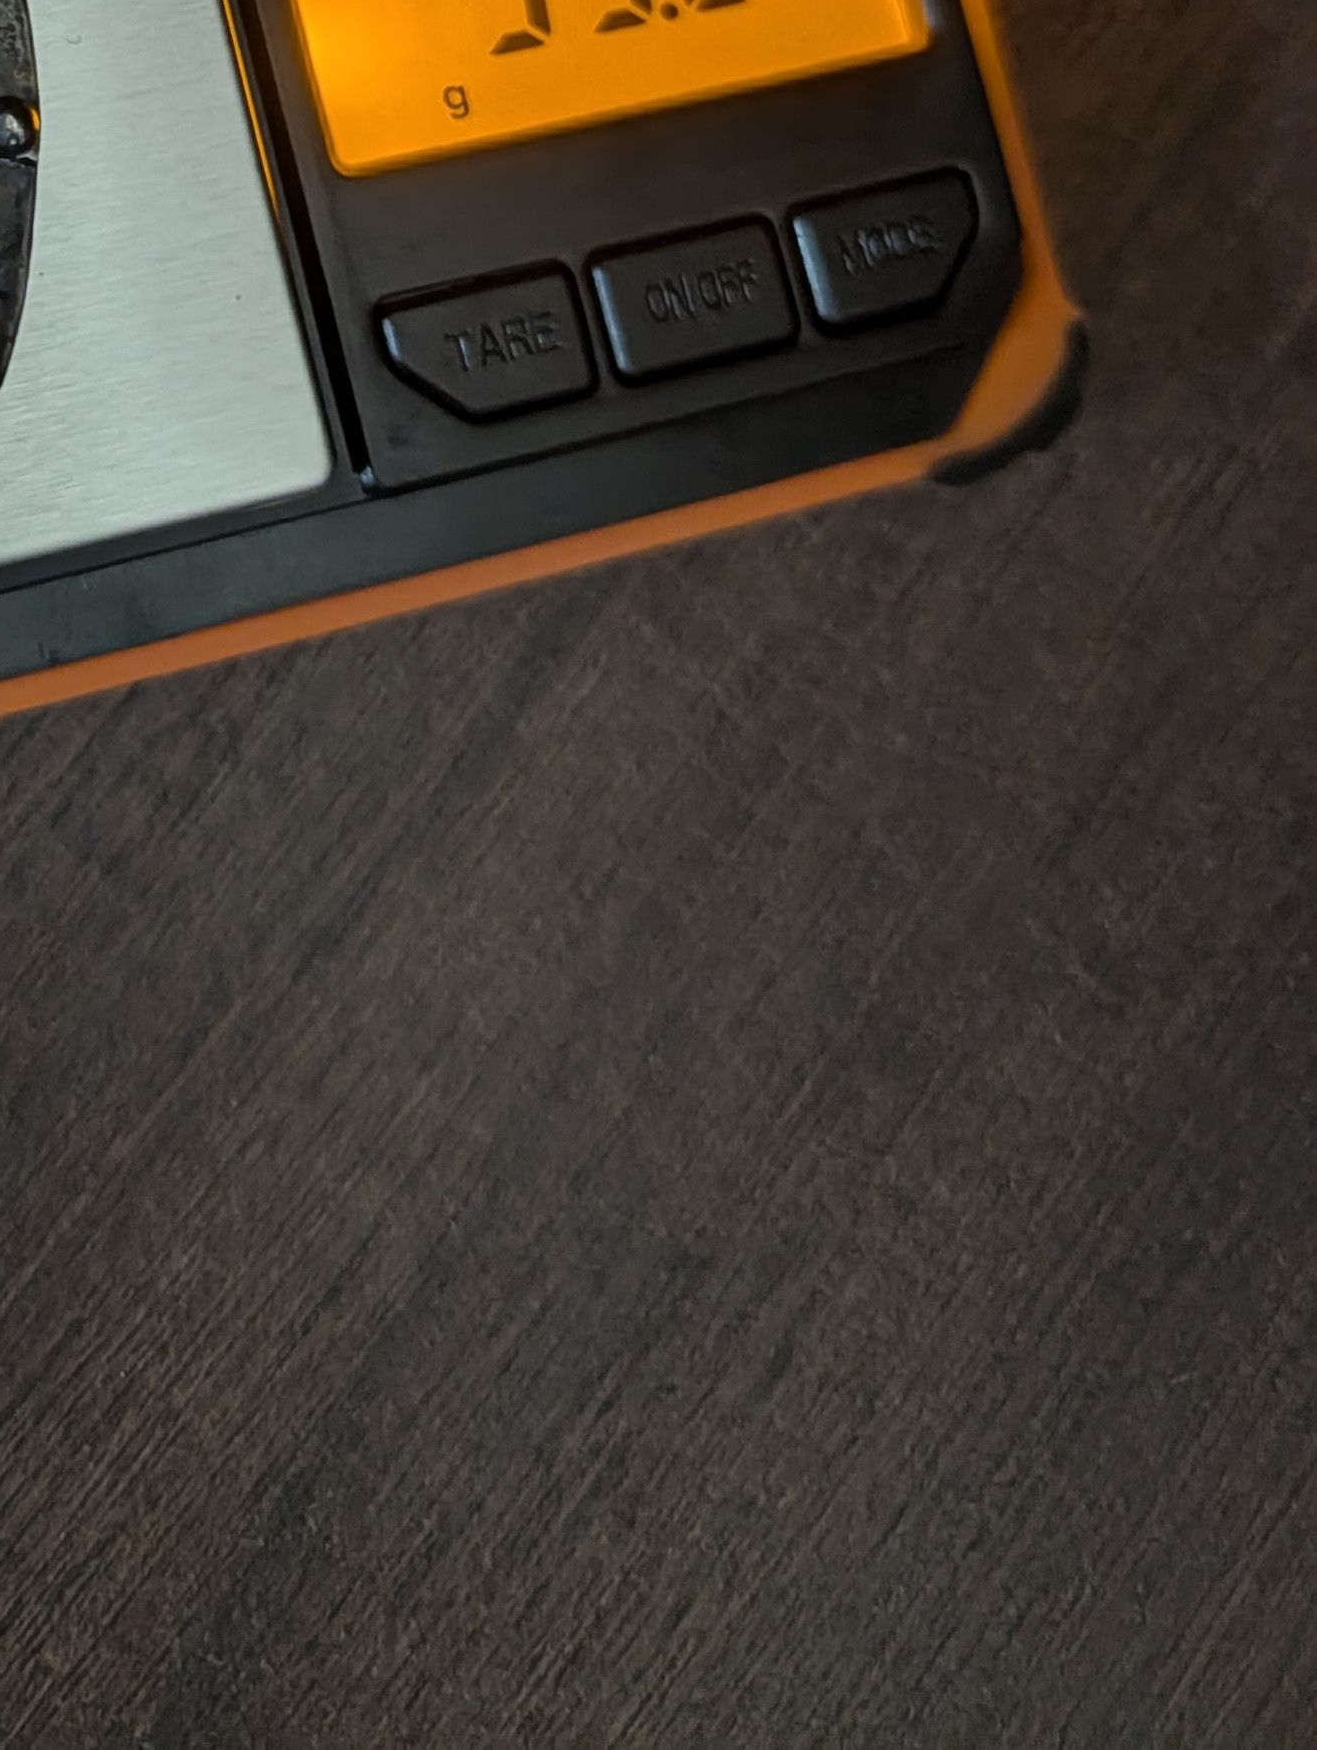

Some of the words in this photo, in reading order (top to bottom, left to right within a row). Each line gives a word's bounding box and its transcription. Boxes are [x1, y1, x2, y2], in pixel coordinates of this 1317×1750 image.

[442, 83, 471, 120] g
[836, 218, 936, 276] MODE
[444, 309, 562, 373] TARE
